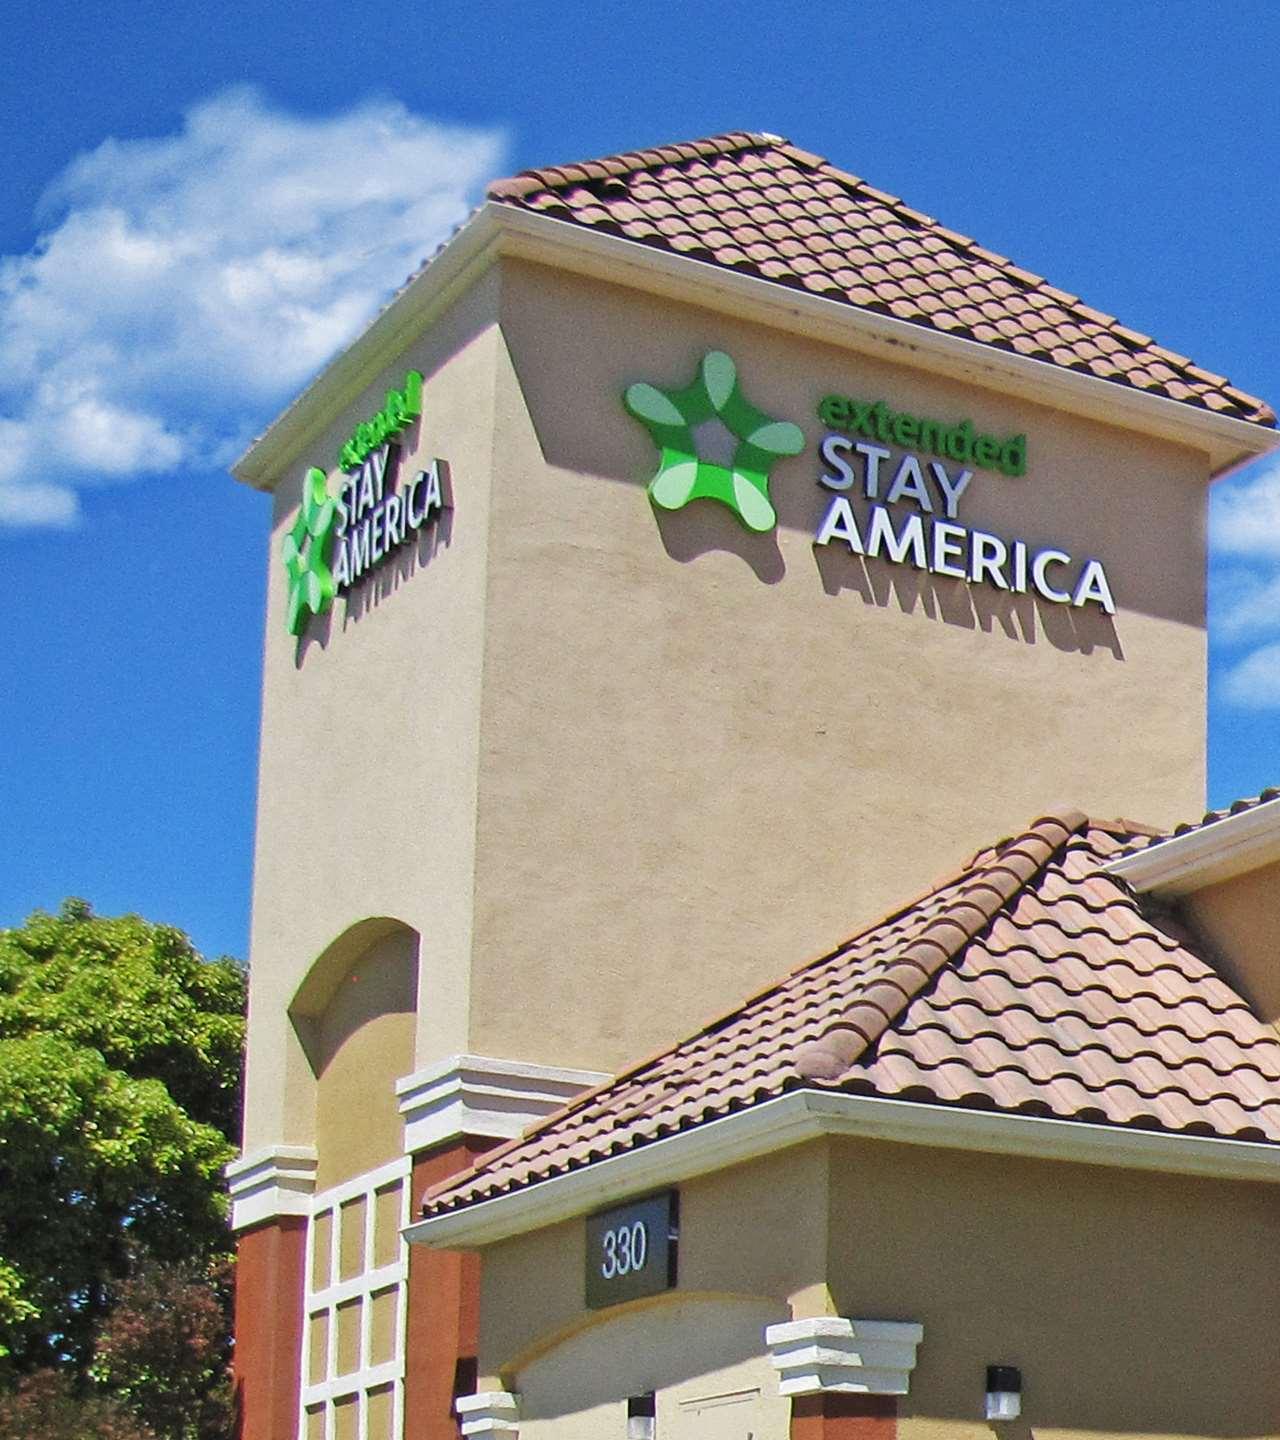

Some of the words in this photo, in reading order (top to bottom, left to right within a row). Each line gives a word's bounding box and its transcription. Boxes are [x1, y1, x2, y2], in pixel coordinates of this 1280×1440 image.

[818, 395, 1027, 476] extended
[820, 434, 974, 519] STAY
[333, 458, 442, 587] AMERICA
[336, 444, 389, 536] STAY
[815, 496, 1117, 616] AMERICA
[602, 1221, 646, 1279] 330
